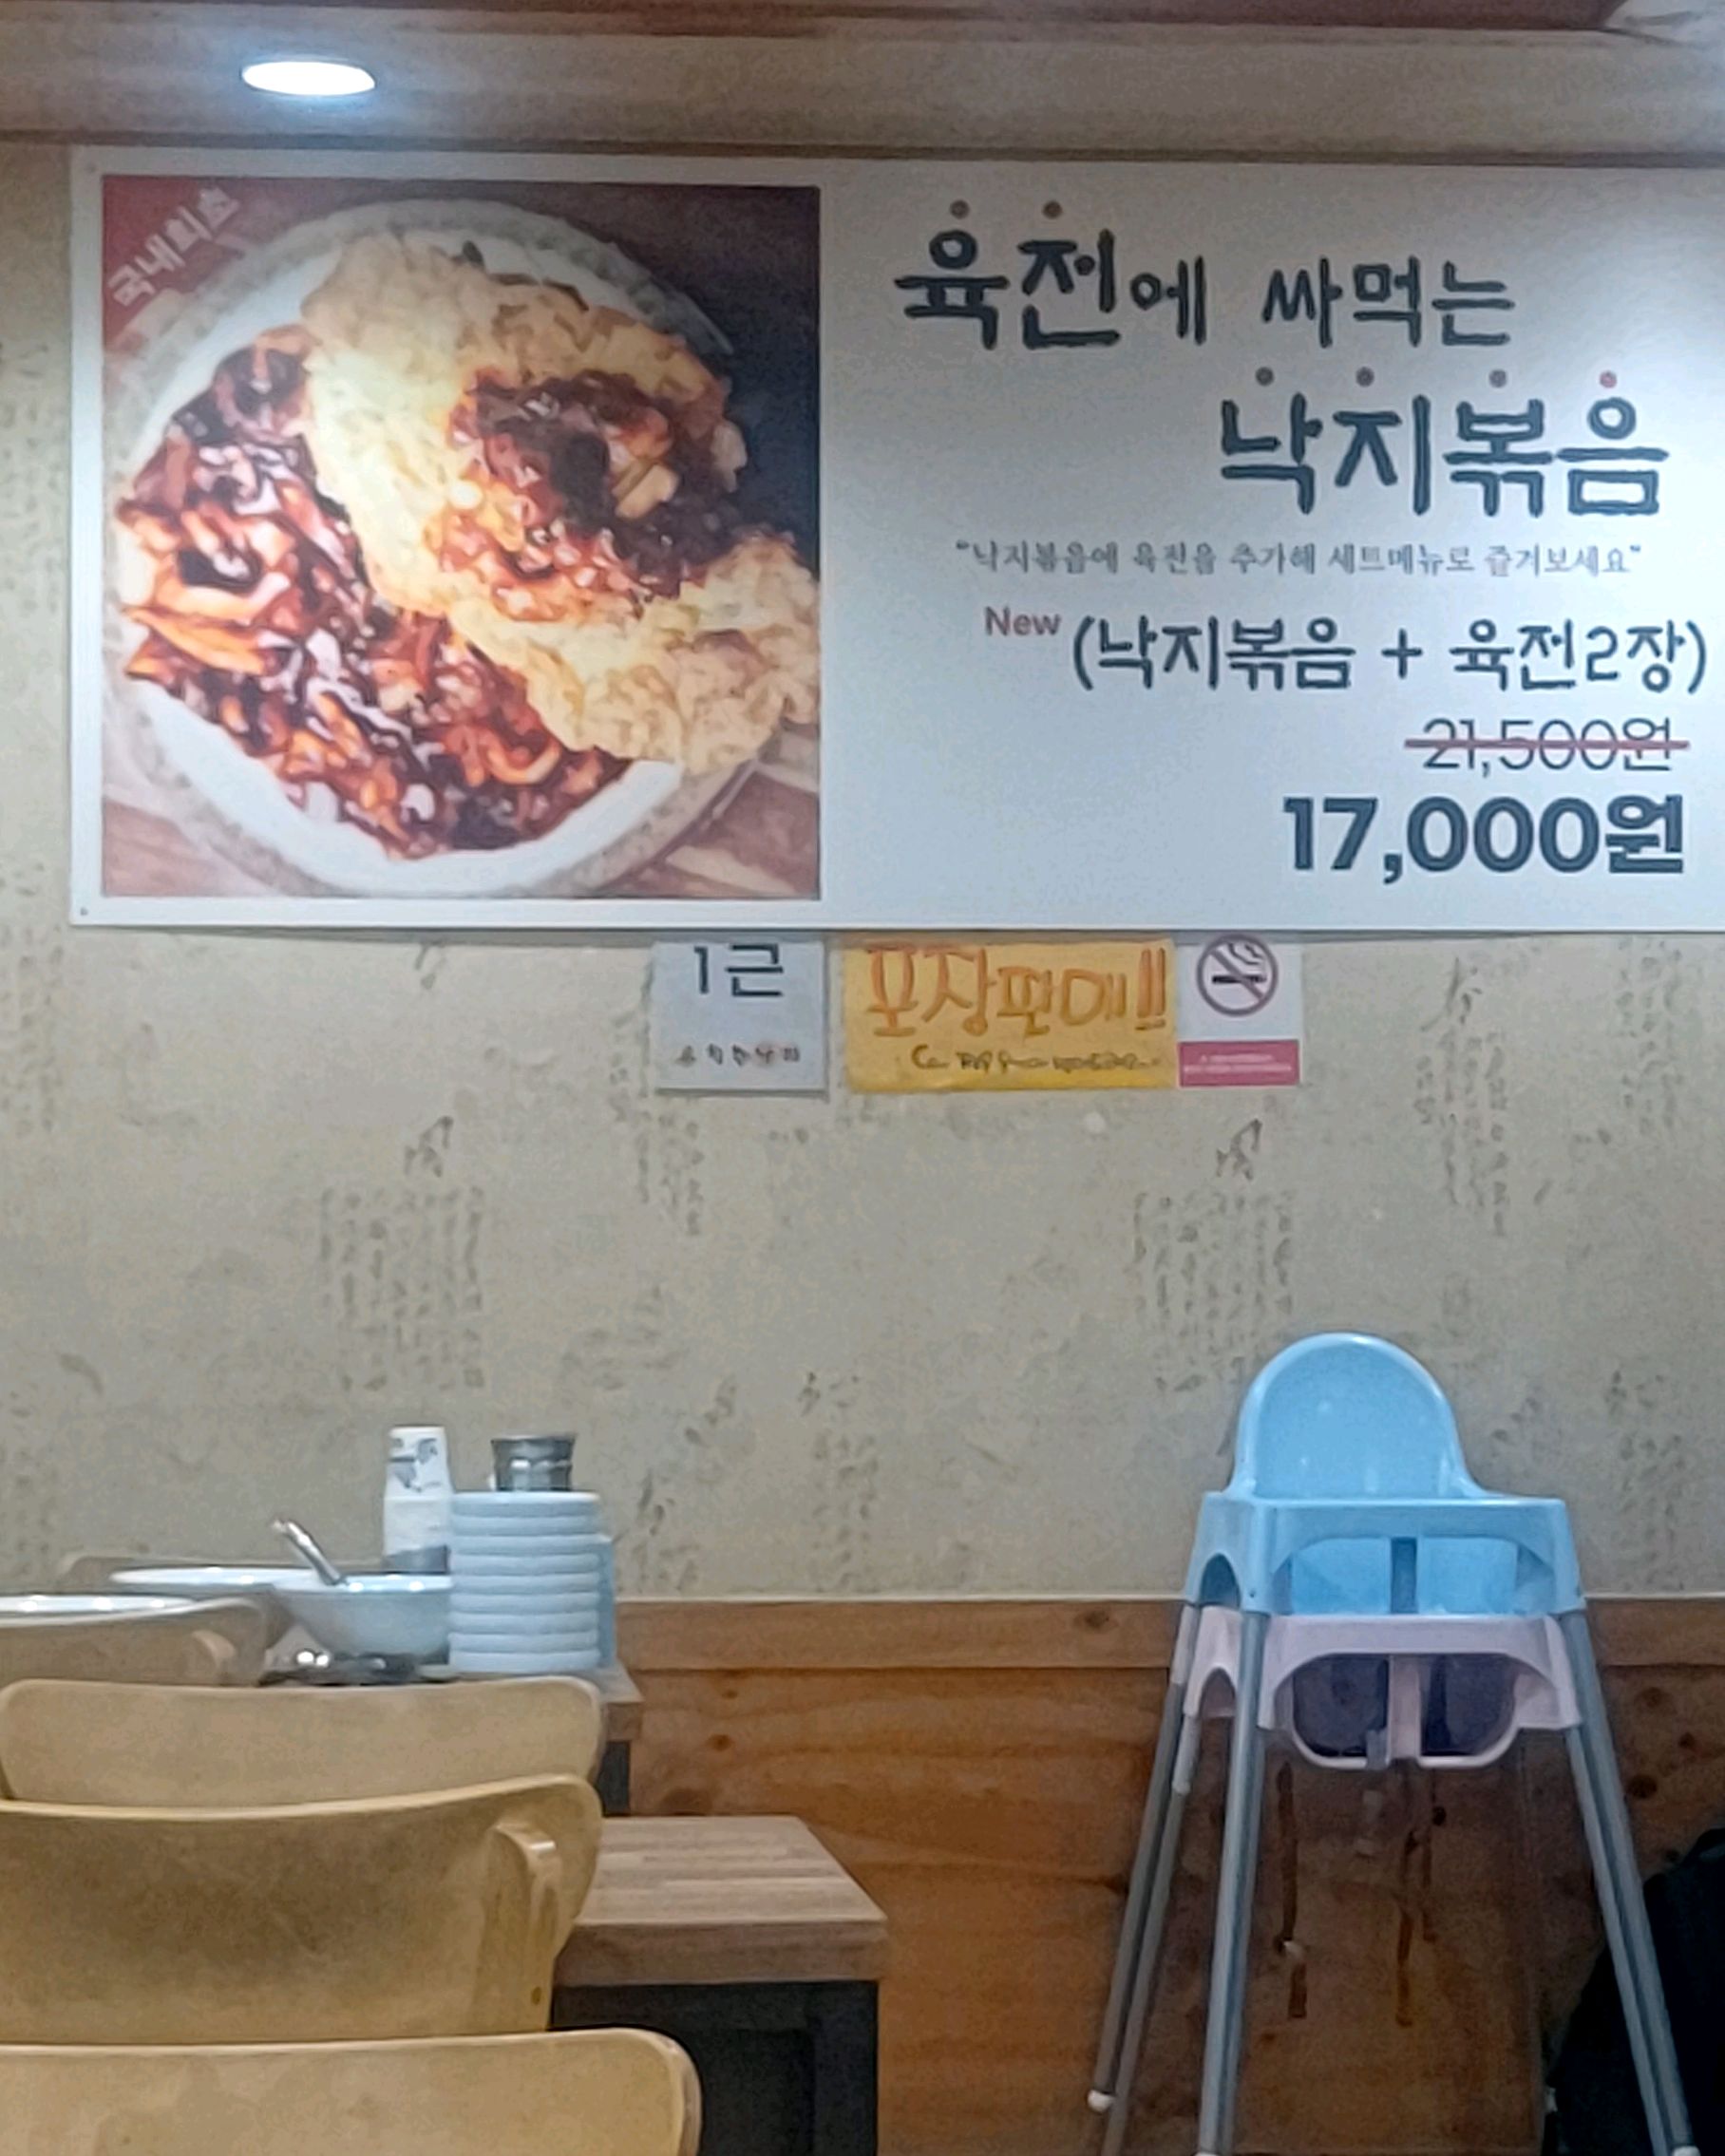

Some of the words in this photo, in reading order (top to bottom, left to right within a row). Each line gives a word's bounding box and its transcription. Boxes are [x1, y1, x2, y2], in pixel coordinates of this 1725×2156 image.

[894, 228, 1206, 350] 육전에
[1262, 255, 1514, 348] 싸먹는
[1220, 391, 1669, 517] 낙지볶음
[1330, 542, 1475, 577] 세트메뉴로
[984, 605, 1062, 637] New
[1071, 615, 1356, 691] (낙지볶음
[1449, 617, 1708, 694] 육전2장)
[1423, 717, 1673, 778] 21,500원
[1282, 794, 1685, 884] 17,000원
